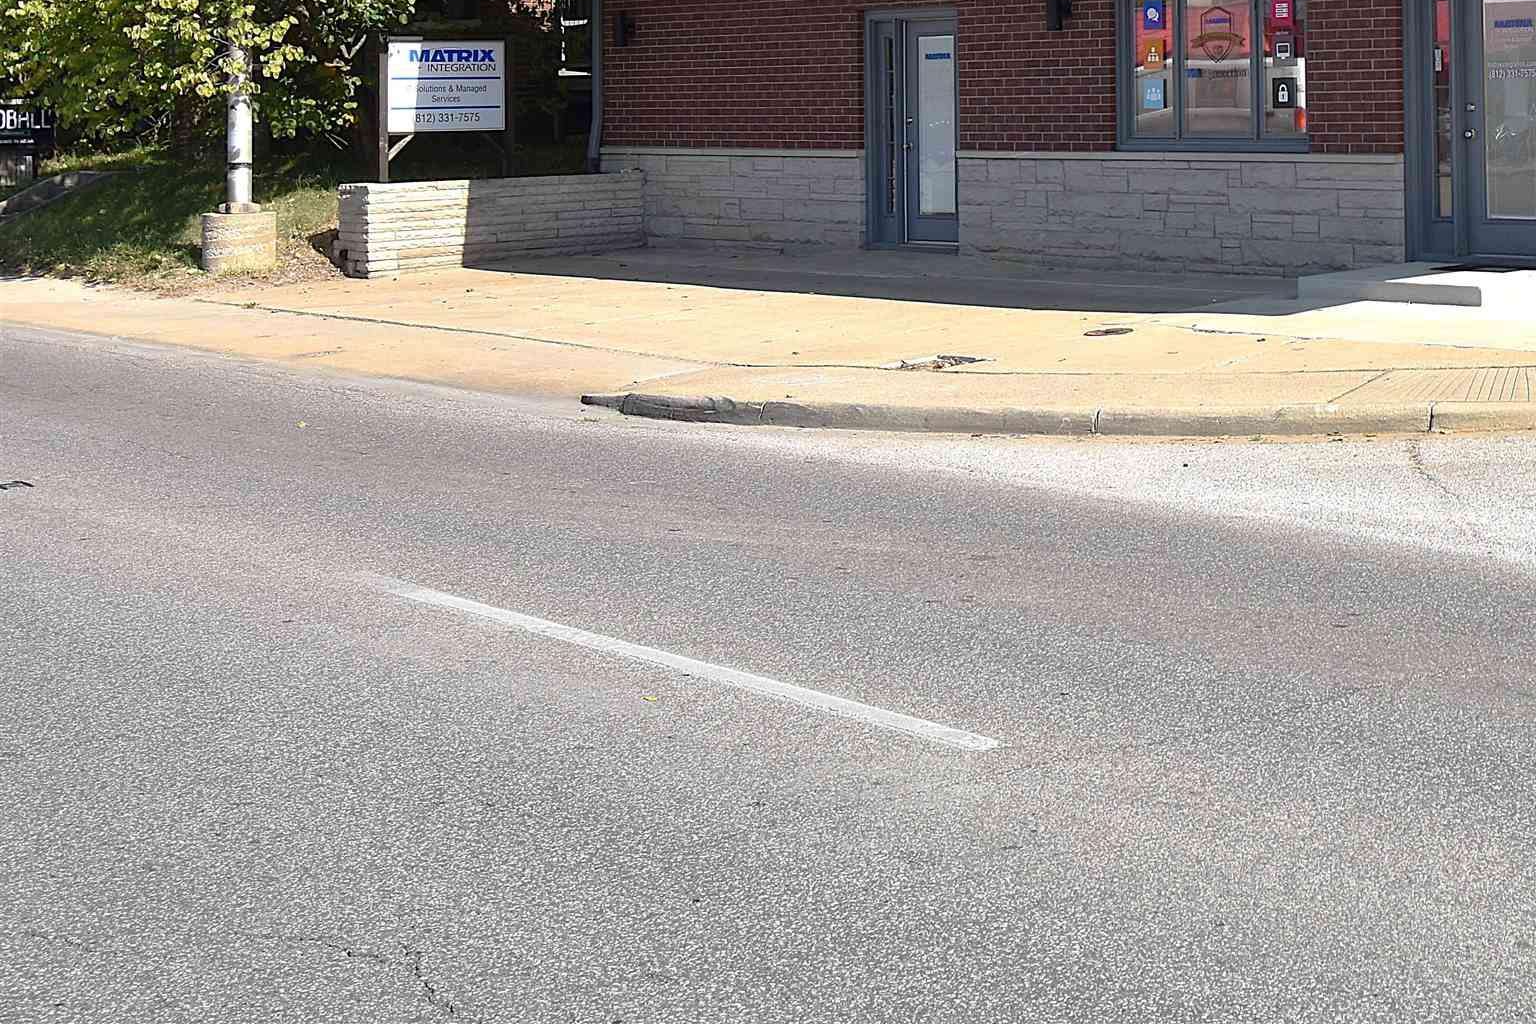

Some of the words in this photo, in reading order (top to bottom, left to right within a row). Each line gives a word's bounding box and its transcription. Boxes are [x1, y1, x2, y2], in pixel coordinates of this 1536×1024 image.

[409, 49, 496, 63] MATRIX
[427, 63, 496, 72] INTEGRATION
[448, 84, 454, 93] &
[456, 84, 487, 96] Managed
[431, 95, 461, 103] Services
[415, 113, 436, 123] 812)
[438, 112, 480, 123] 331-7575
